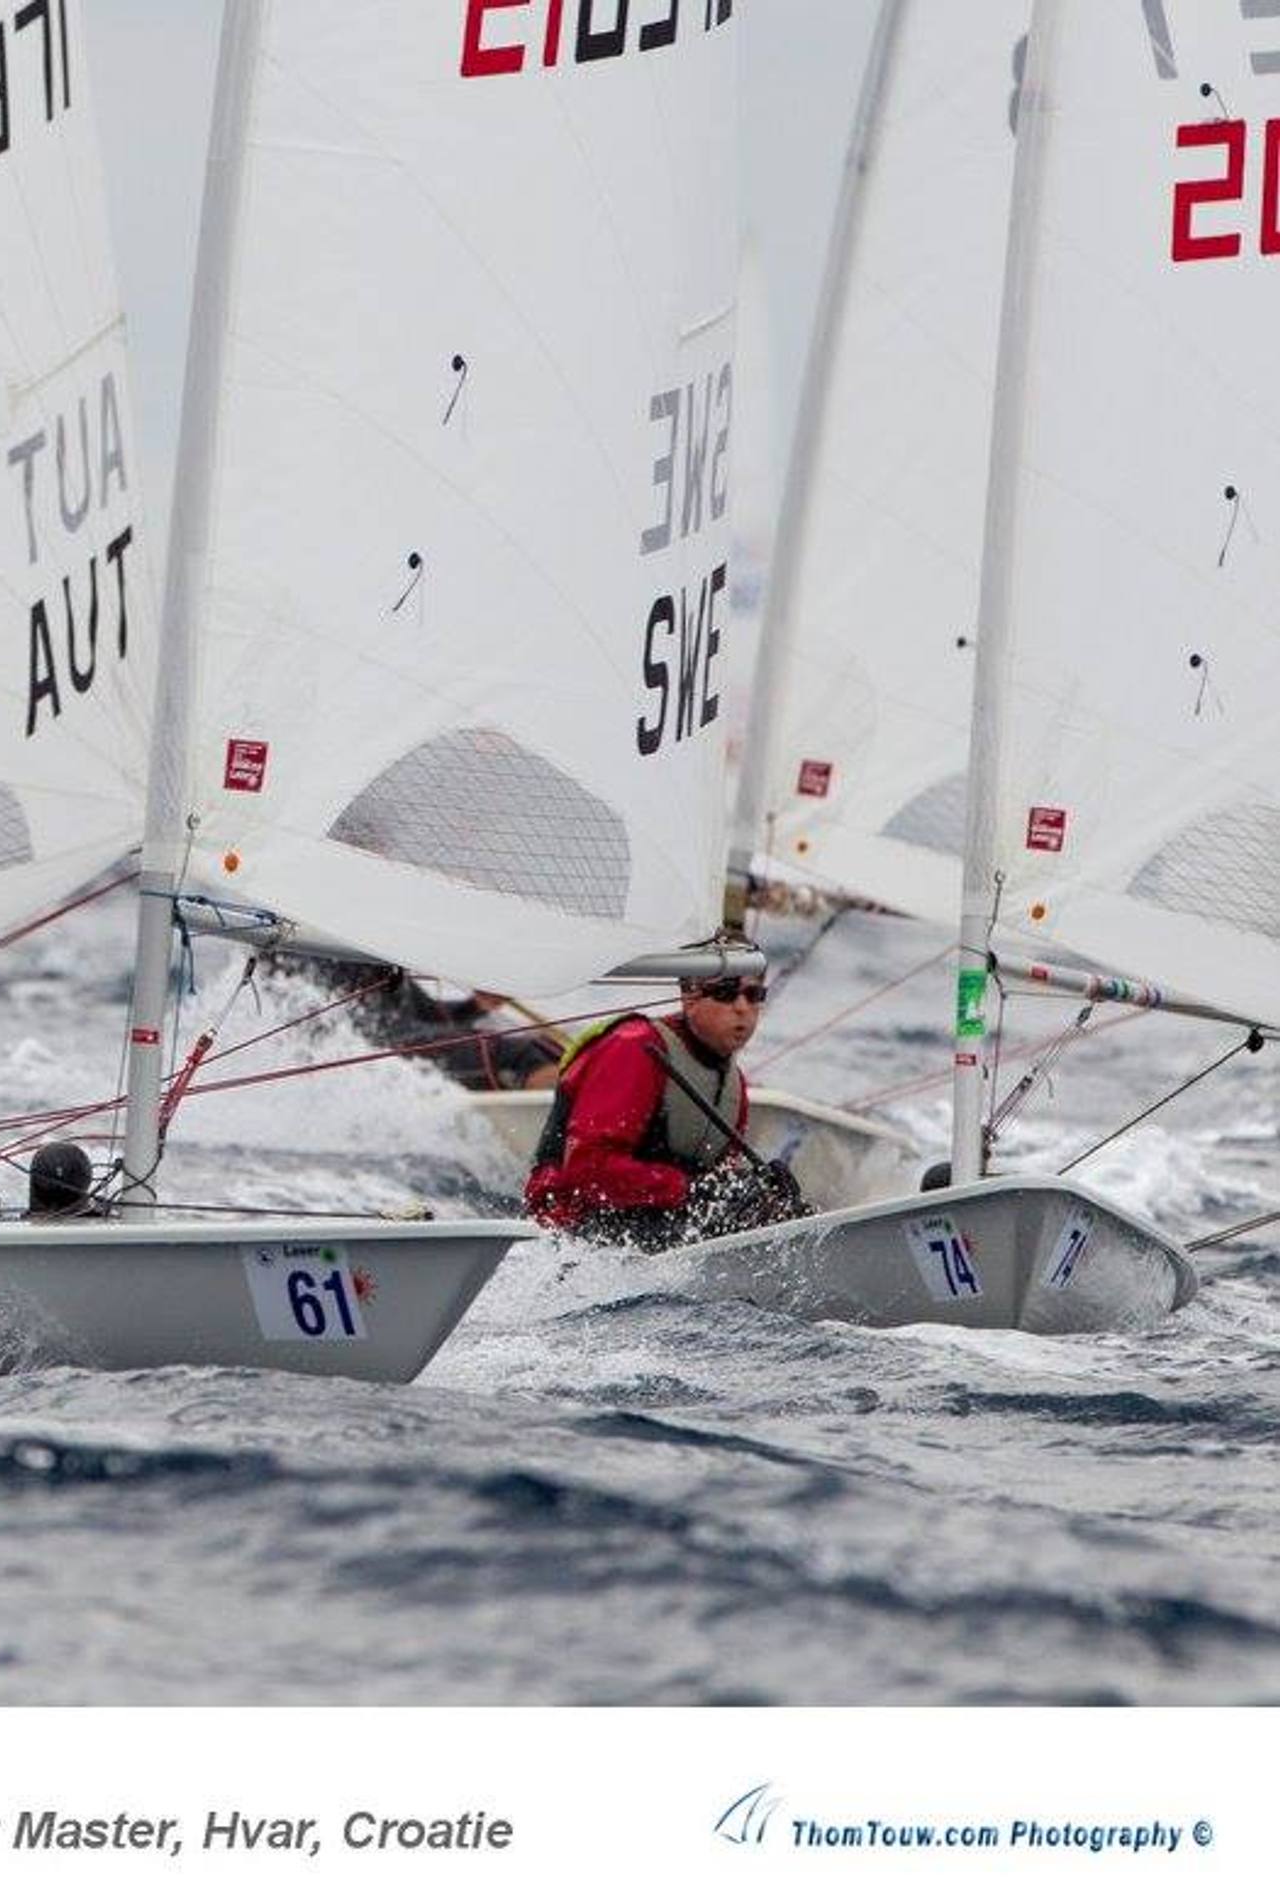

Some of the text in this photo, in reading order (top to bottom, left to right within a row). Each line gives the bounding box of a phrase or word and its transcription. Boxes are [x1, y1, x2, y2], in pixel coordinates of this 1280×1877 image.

[1172, 118, 1280, 262] 2
[25, 524, 133, 738] AUT
[636, 562, 727, 757] SWE
[287, 1270, 356, 1336] 61
[928, 1236, 979, 1297] 74
